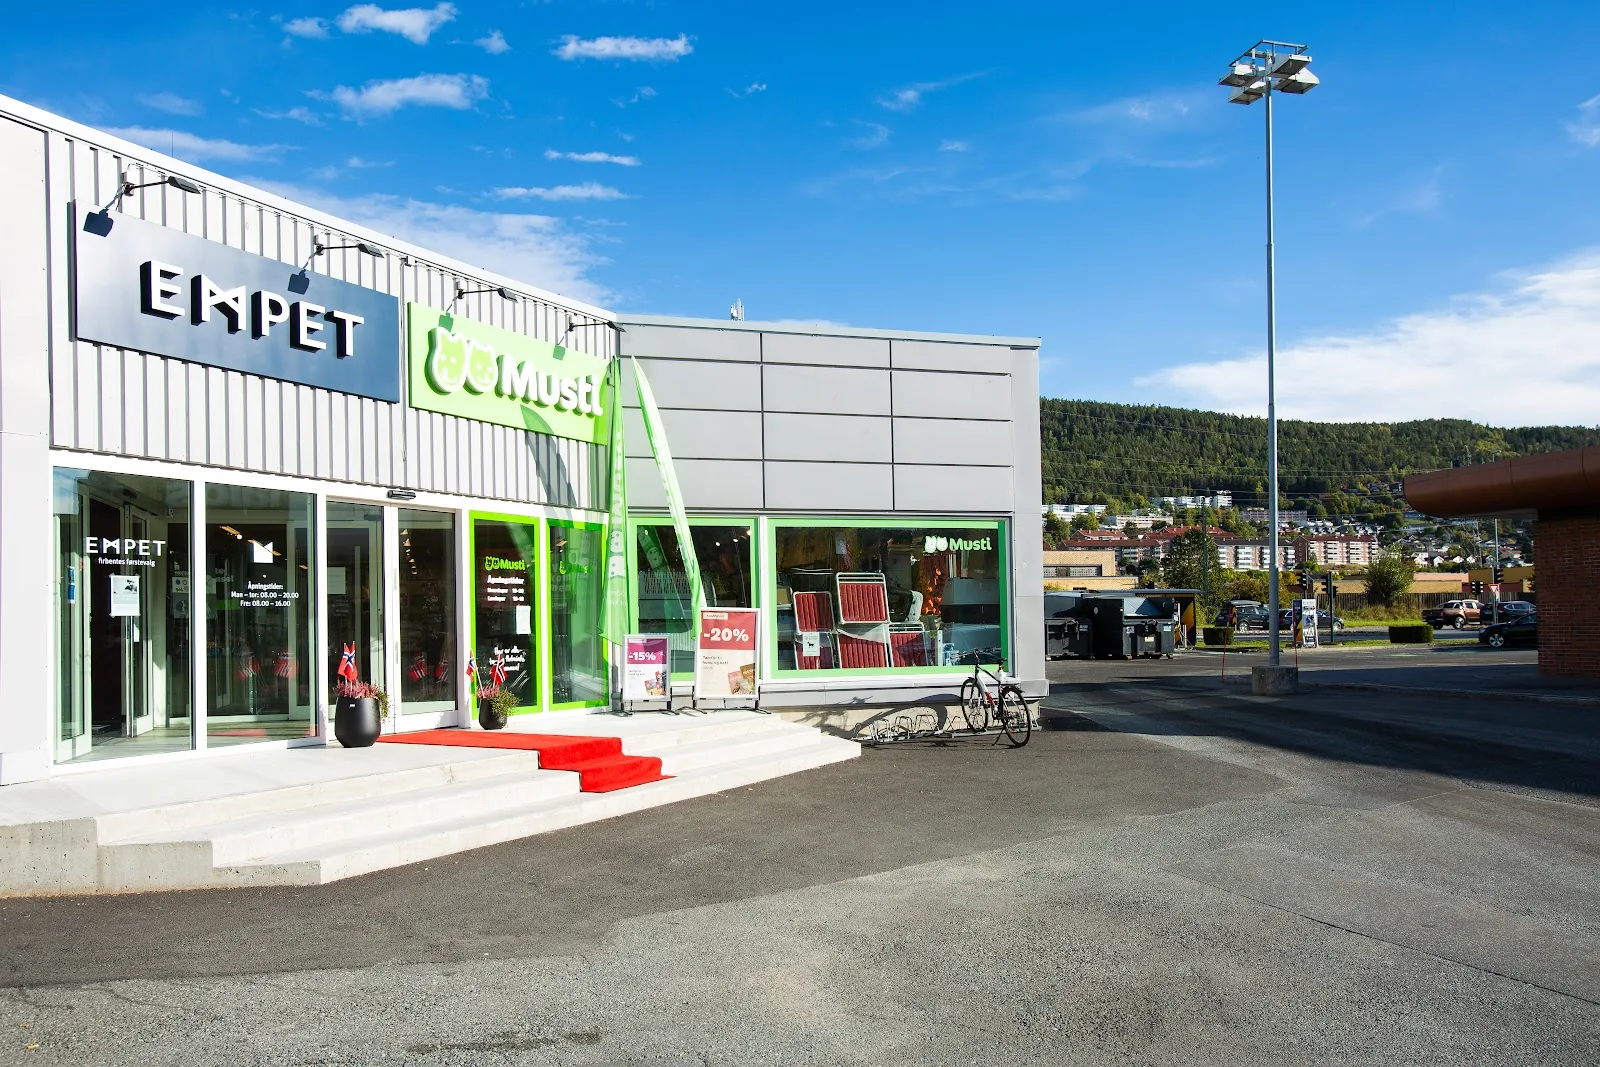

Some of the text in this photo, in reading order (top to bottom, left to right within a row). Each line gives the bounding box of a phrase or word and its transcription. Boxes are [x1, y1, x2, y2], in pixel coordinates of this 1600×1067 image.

[140, 260, 365, 359] EMPET
[495, 354, 603, 419] Musti
[86, 537, 166, 557] EMPET
[949, 537, 992, 550] Musti
[98, 557, 125, 565] firbentes
[500, 559, 525, 570] Musti
[704, 627, 749, 642] -20%
[628, 651, 656, 661] -15%
